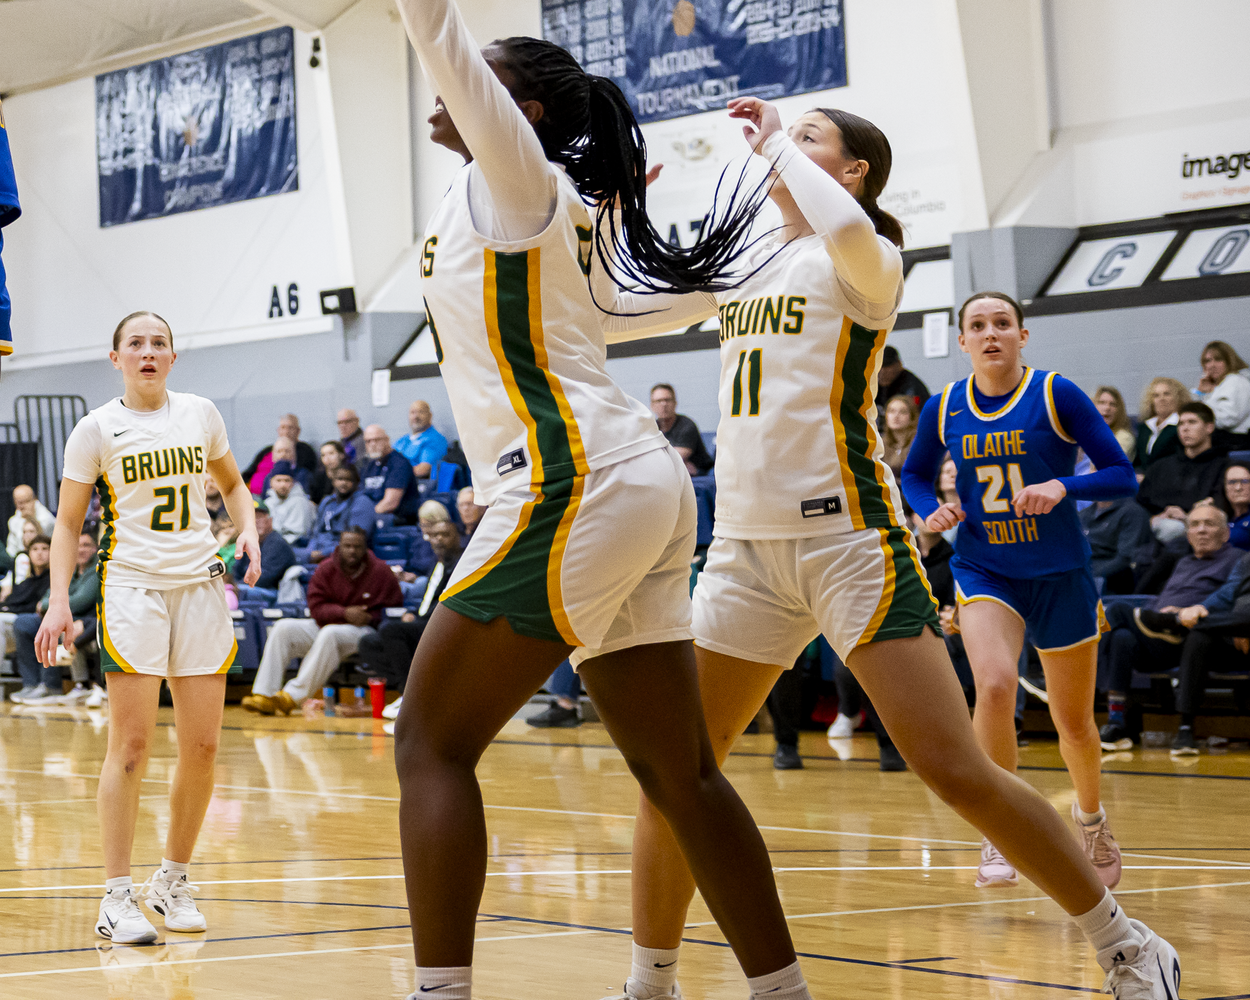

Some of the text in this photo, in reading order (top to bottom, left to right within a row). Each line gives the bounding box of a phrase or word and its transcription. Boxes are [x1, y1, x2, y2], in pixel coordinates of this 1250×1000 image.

[1088, 243, 1138, 287] C
[268, 283, 299, 318] A6
[730, 348, 763, 417] 11
[962, 429, 1027, 459] OLATHE
[121, 446, 203, 484] BRUINS
[150, 484, 191, 532] 21
[976, 463, 1025, 514] 21
[982, 517, 1039, 545] SOUTH
